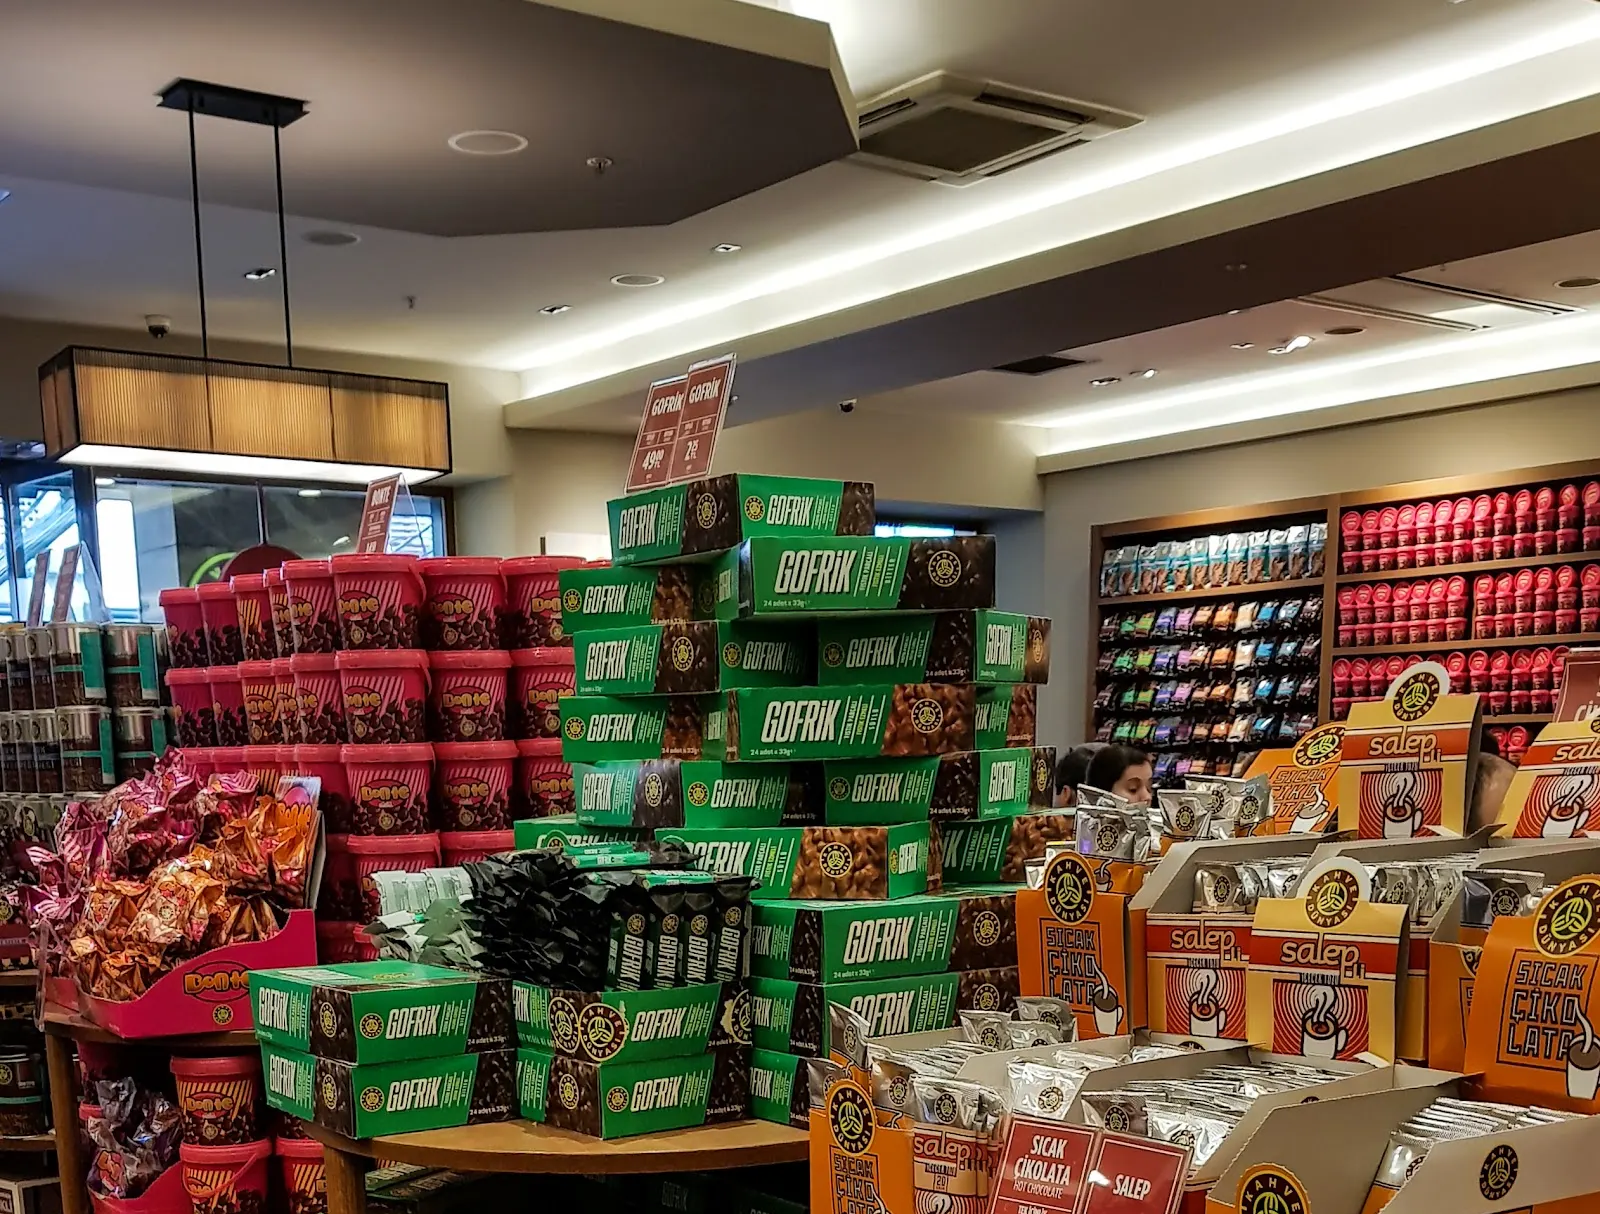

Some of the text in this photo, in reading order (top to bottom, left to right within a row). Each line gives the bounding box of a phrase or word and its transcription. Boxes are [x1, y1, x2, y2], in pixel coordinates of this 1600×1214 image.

[1398, 673, 1439, 694] KAHVE
[1394, 700, 1434, 721] DÜNYASI
[1050, 861, 1089, 884] KAHVE
[1313, 871, 1358, 893] KAHVE
[1050, 897, 1090, 922] DÜNYASI
[1308, 904, 1353, 926] DÜNYASI
[1046, 927, 1096, 951] SICAK
[1539, 924, 1595, 953] DÜNYASI
[1515, 960, 1588, 991] SICAK
[831, 1090, 869, 1118] KAHVE
[832, 1126, 872, 1152] DÜNYASI
[1030, 1134, 1068, 1159] SICAK
[834, 1153, 874, 1178] SICAK
[1013, 1154, 1071, 1186] ÇİKOLATA
[1013, 1179, 1064, 1200] HOT CHOCOLATE
[1112, 1174, 1152, 1201] SALEP
[1244, 1176, 1301, 1213] KAHVE
